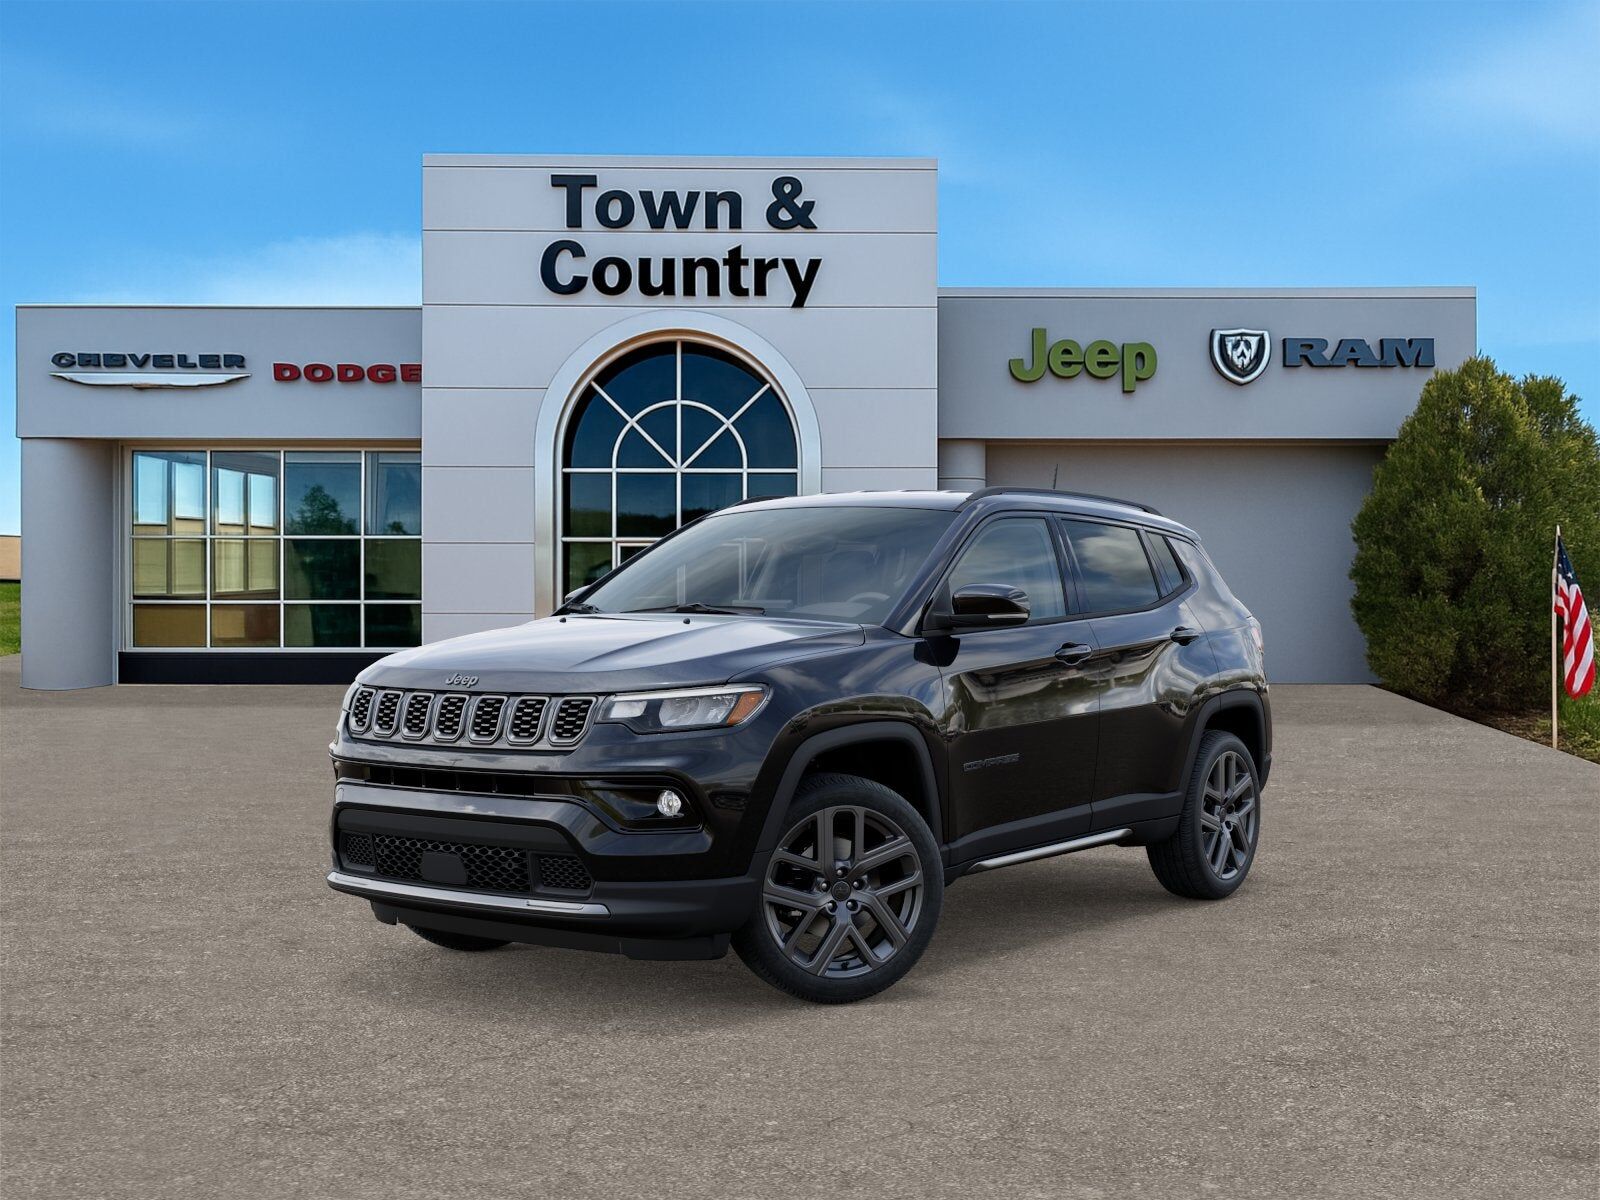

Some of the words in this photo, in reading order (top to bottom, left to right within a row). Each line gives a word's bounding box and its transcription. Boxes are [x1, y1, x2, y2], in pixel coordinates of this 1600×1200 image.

[550, 174, 742, 229] Town
[765, 176, 818, 229] &
[540, 239, 822, 308] Country
[273, 362, 422, 383] DODGE
[1008, 327, 1158, 393] Jeep
[1282, 337, 1436, 368] RAM
[445, 673, 480, 688] Jeep
